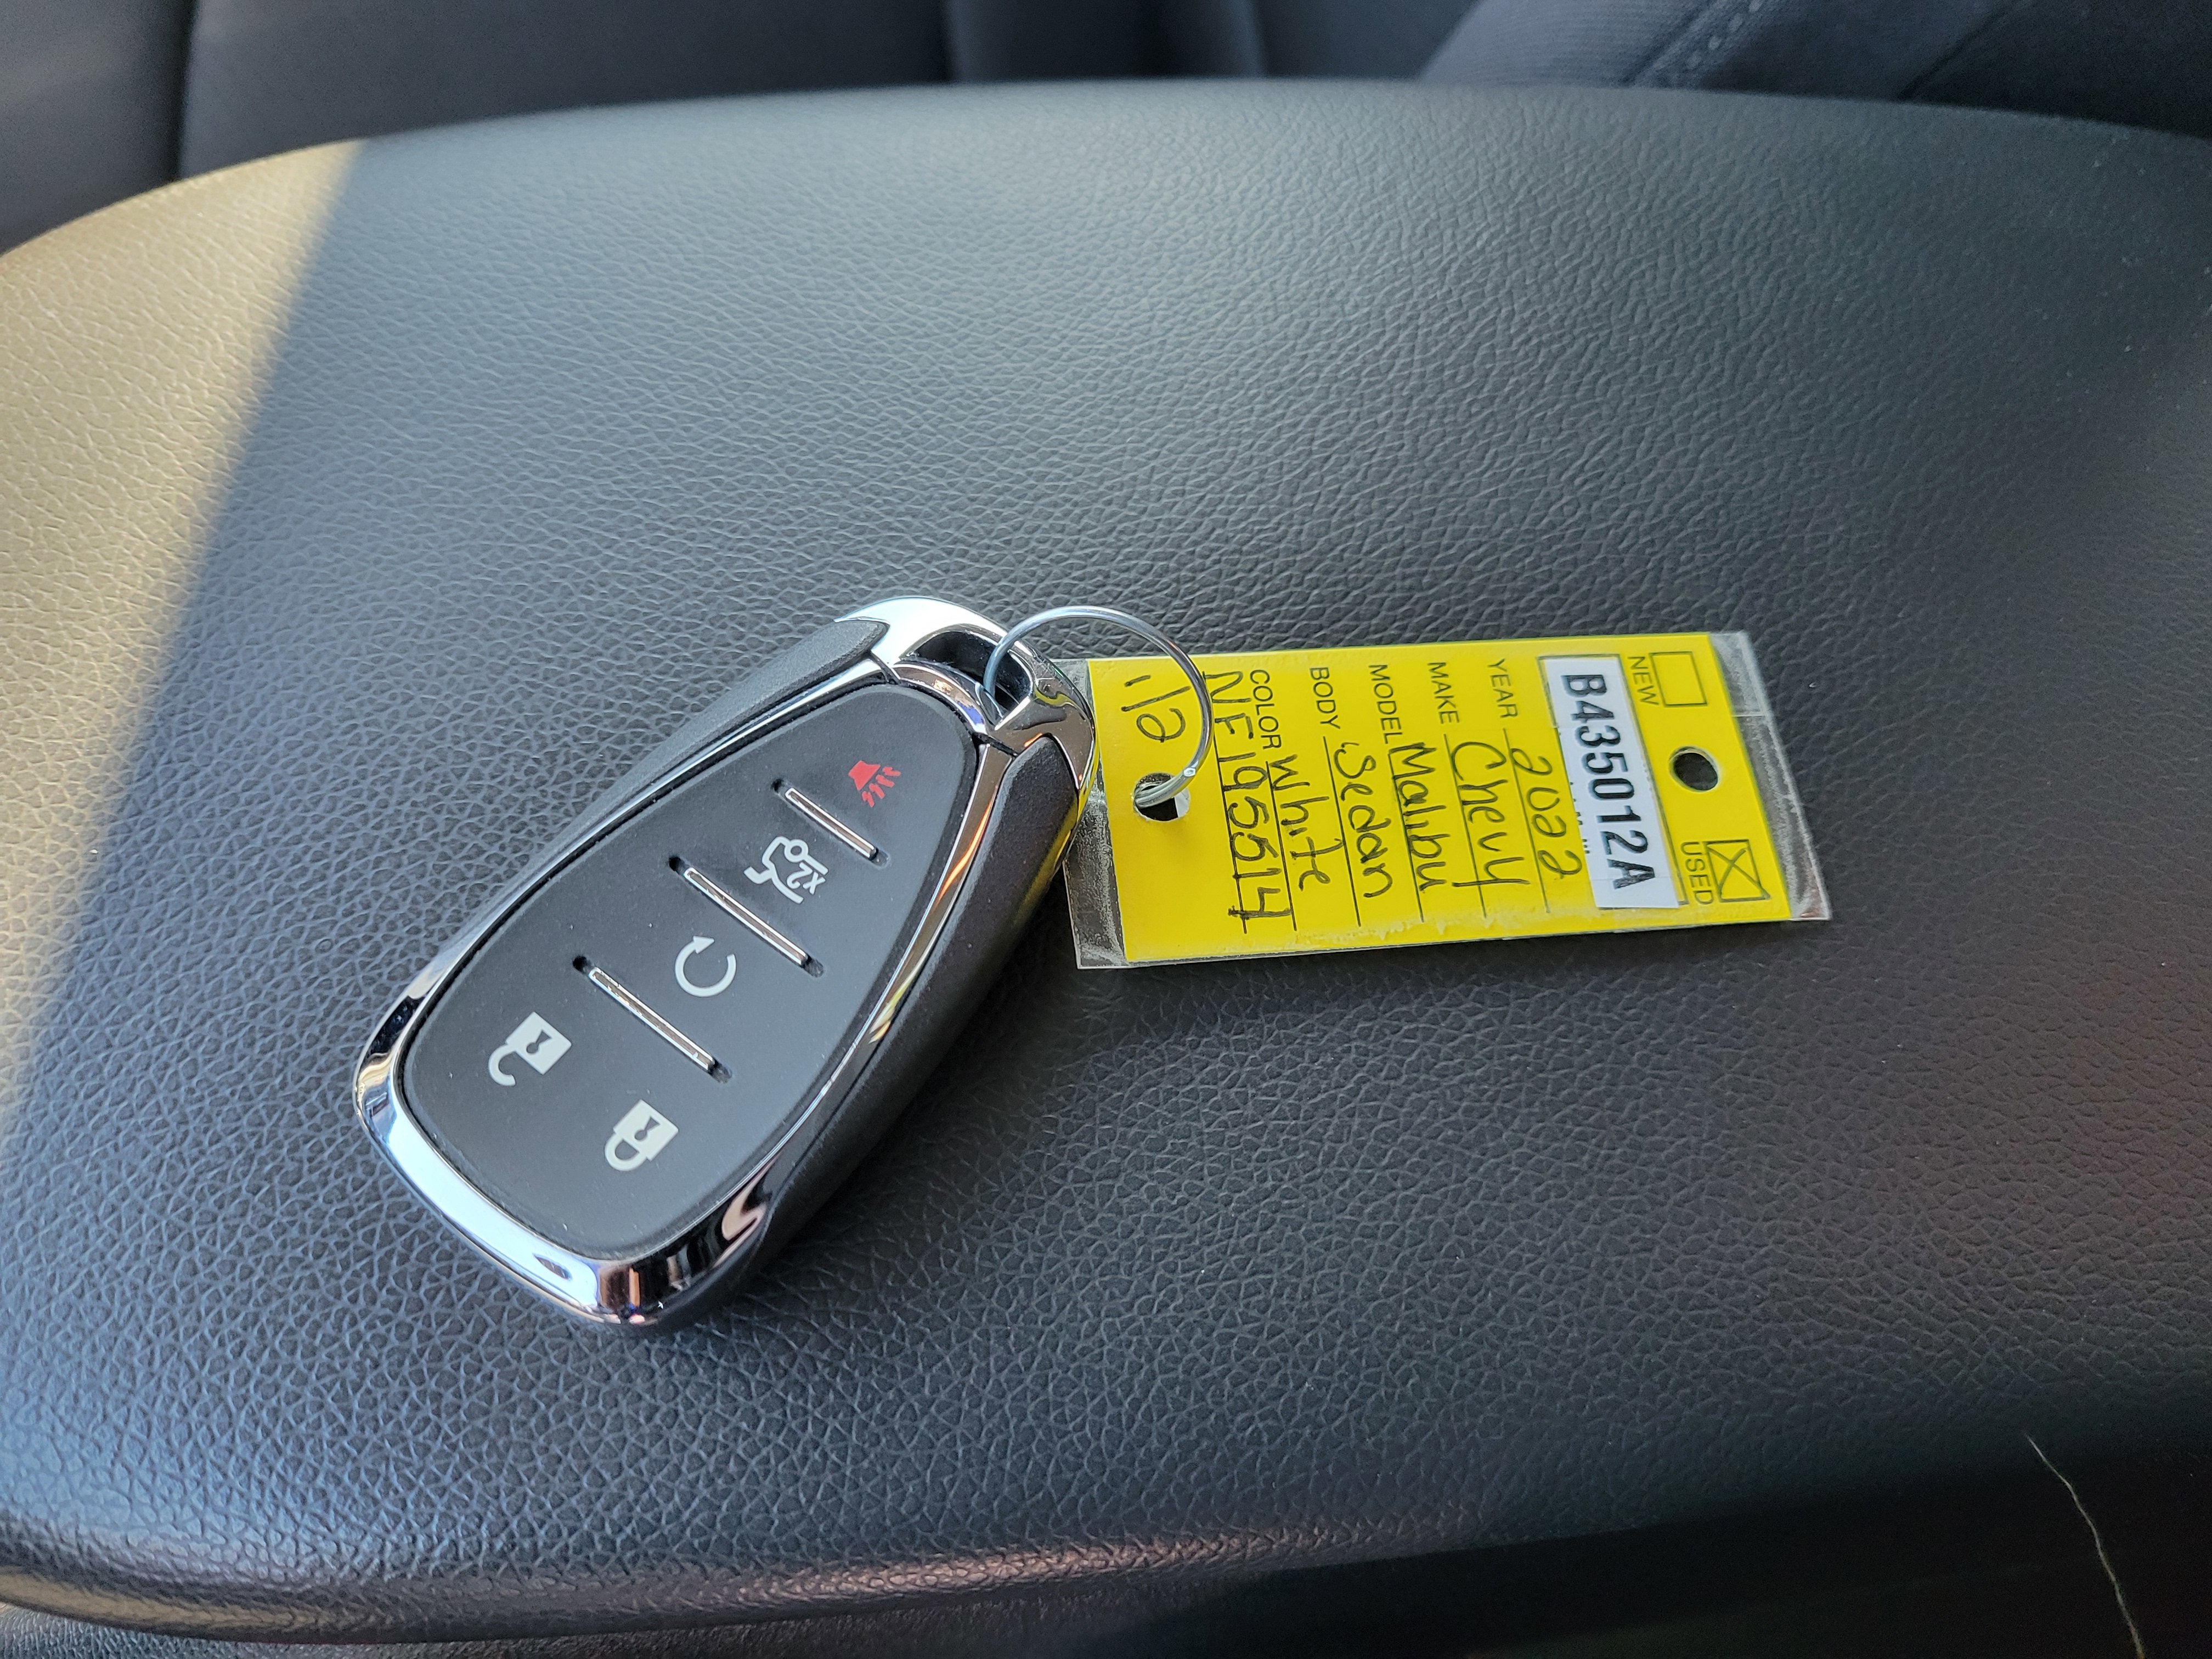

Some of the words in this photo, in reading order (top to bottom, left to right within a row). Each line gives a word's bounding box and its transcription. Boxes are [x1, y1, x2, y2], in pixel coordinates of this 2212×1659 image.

[1250, 669, 1282, 749] COLOR
[1310, 667, 1340, 729] BODY
[1369, 664, 1402, 743] MODEL
[1428, 662, 1459, 724] MAKE
[1488, 659, 1518, 718] YEAR
[1628, 656, 1659, 706] NEW
[1334, 742, 1392, 898] Sedan
[1389, 742, 1450, 894] Malibu
[1451, 741, 1530, 887] Chevy
[1511, 748, 1582, 879] 2022
[1561, 675, 1655, 889] B435012A
[1680, 841, 1713, 905] USED
